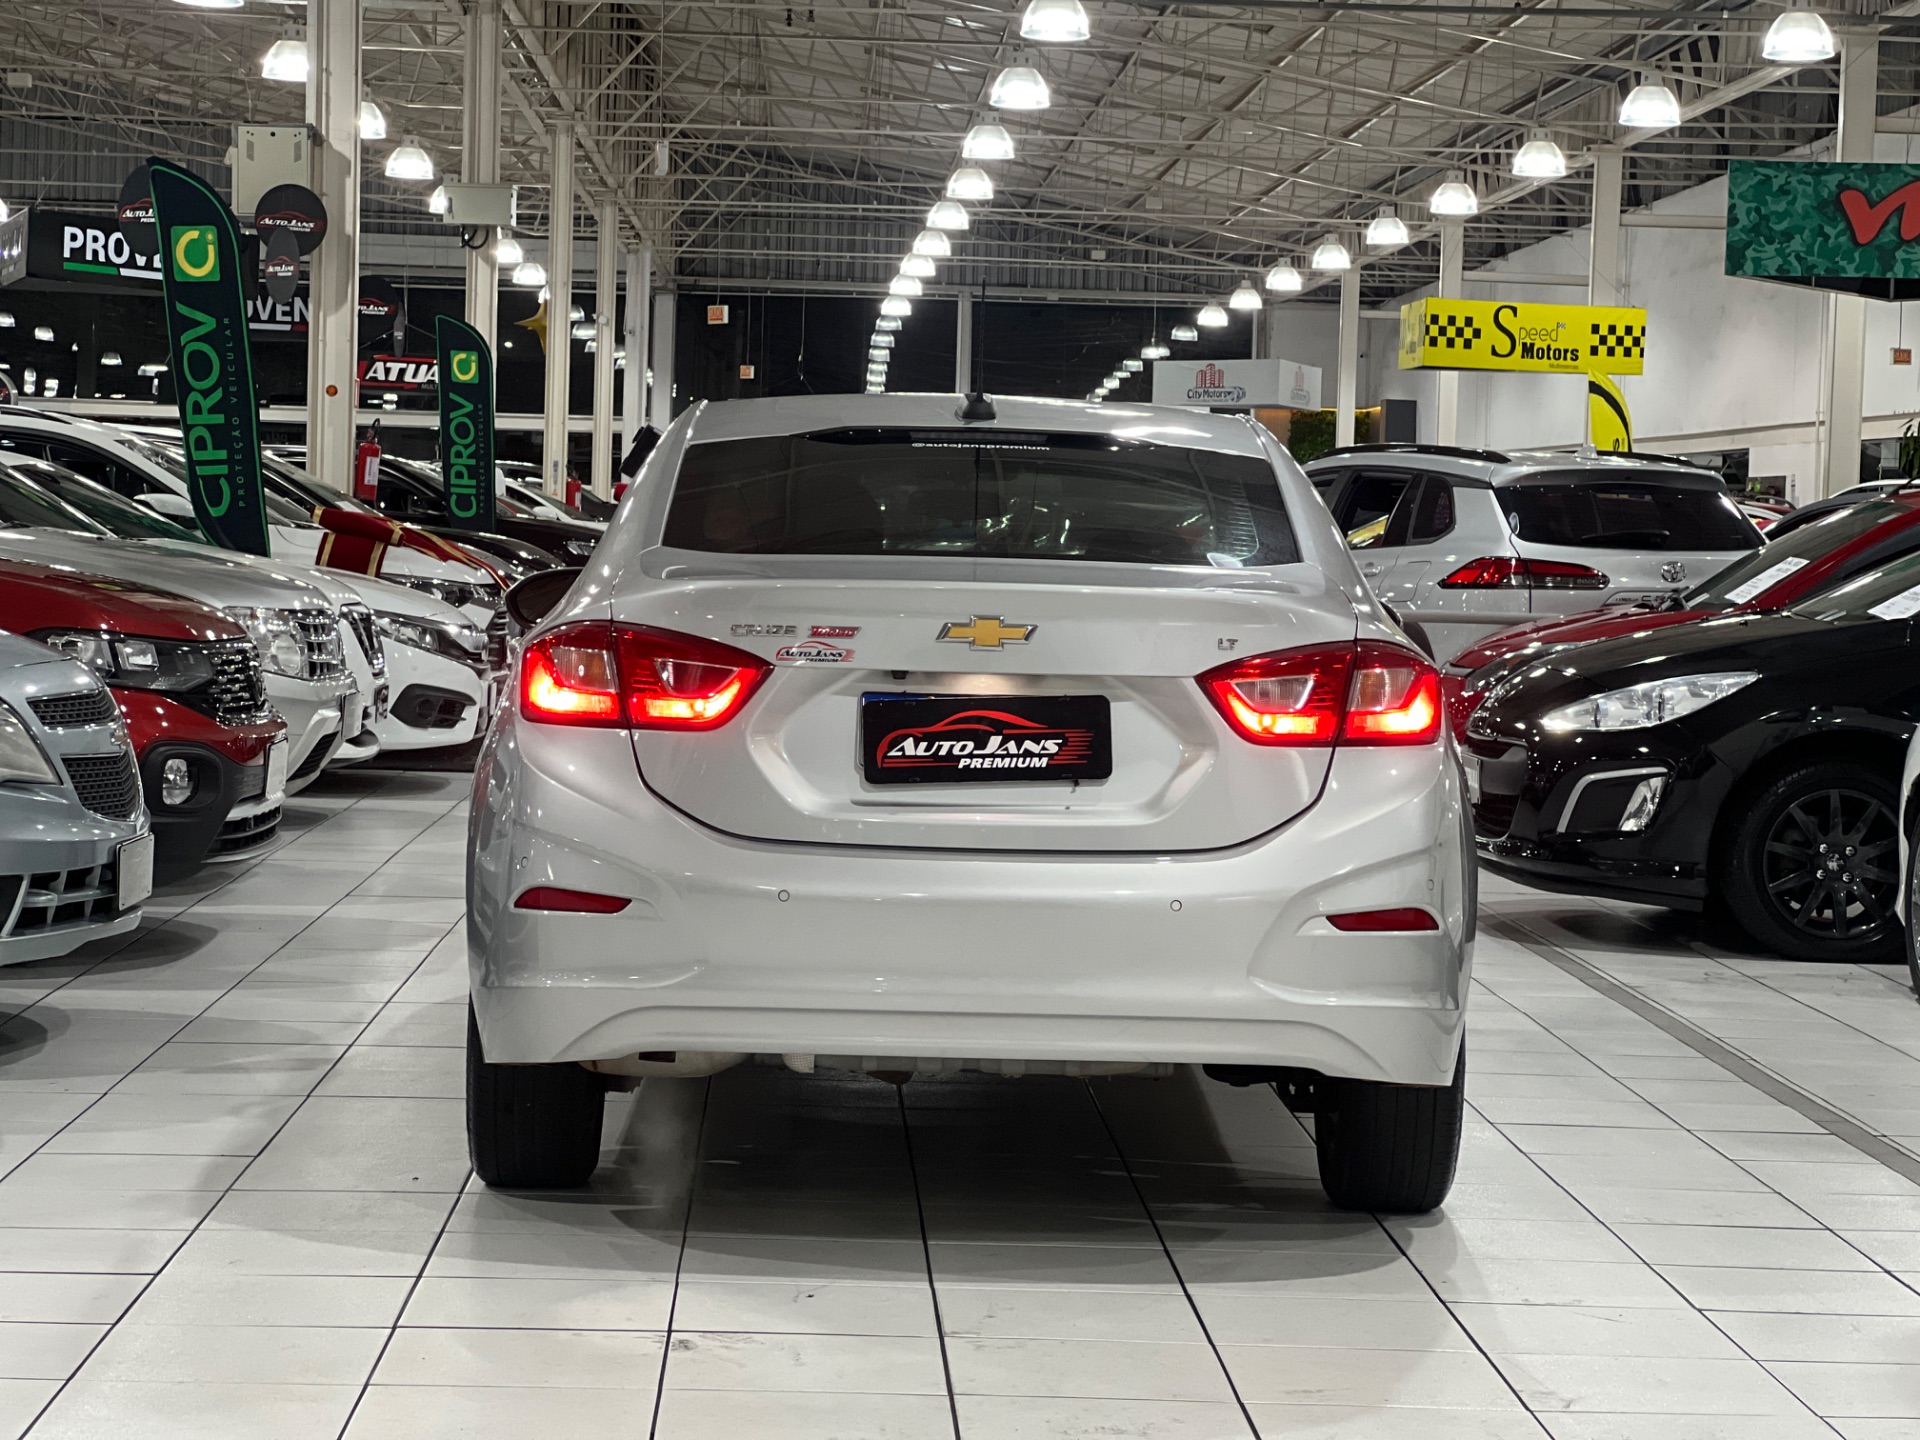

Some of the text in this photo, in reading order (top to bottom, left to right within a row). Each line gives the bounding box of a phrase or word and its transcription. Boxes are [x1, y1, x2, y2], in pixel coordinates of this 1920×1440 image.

[122, 208, 155, 218] AUTOJ
[1490, 304, 1559, 358] Speed
[1521, 342, 1580, 362] Motors
[1187, 388, 1228, 400] City Motors
[175, 300, 231, 518] CIPROV
[223, 317, 246, 507] PROTEÇÃO VEICULAR
[449, 391, 477, 518] CIPROV
[1217, 638, 1239, 651] LT
[957, 756, 1049, 769] PREMIUM
